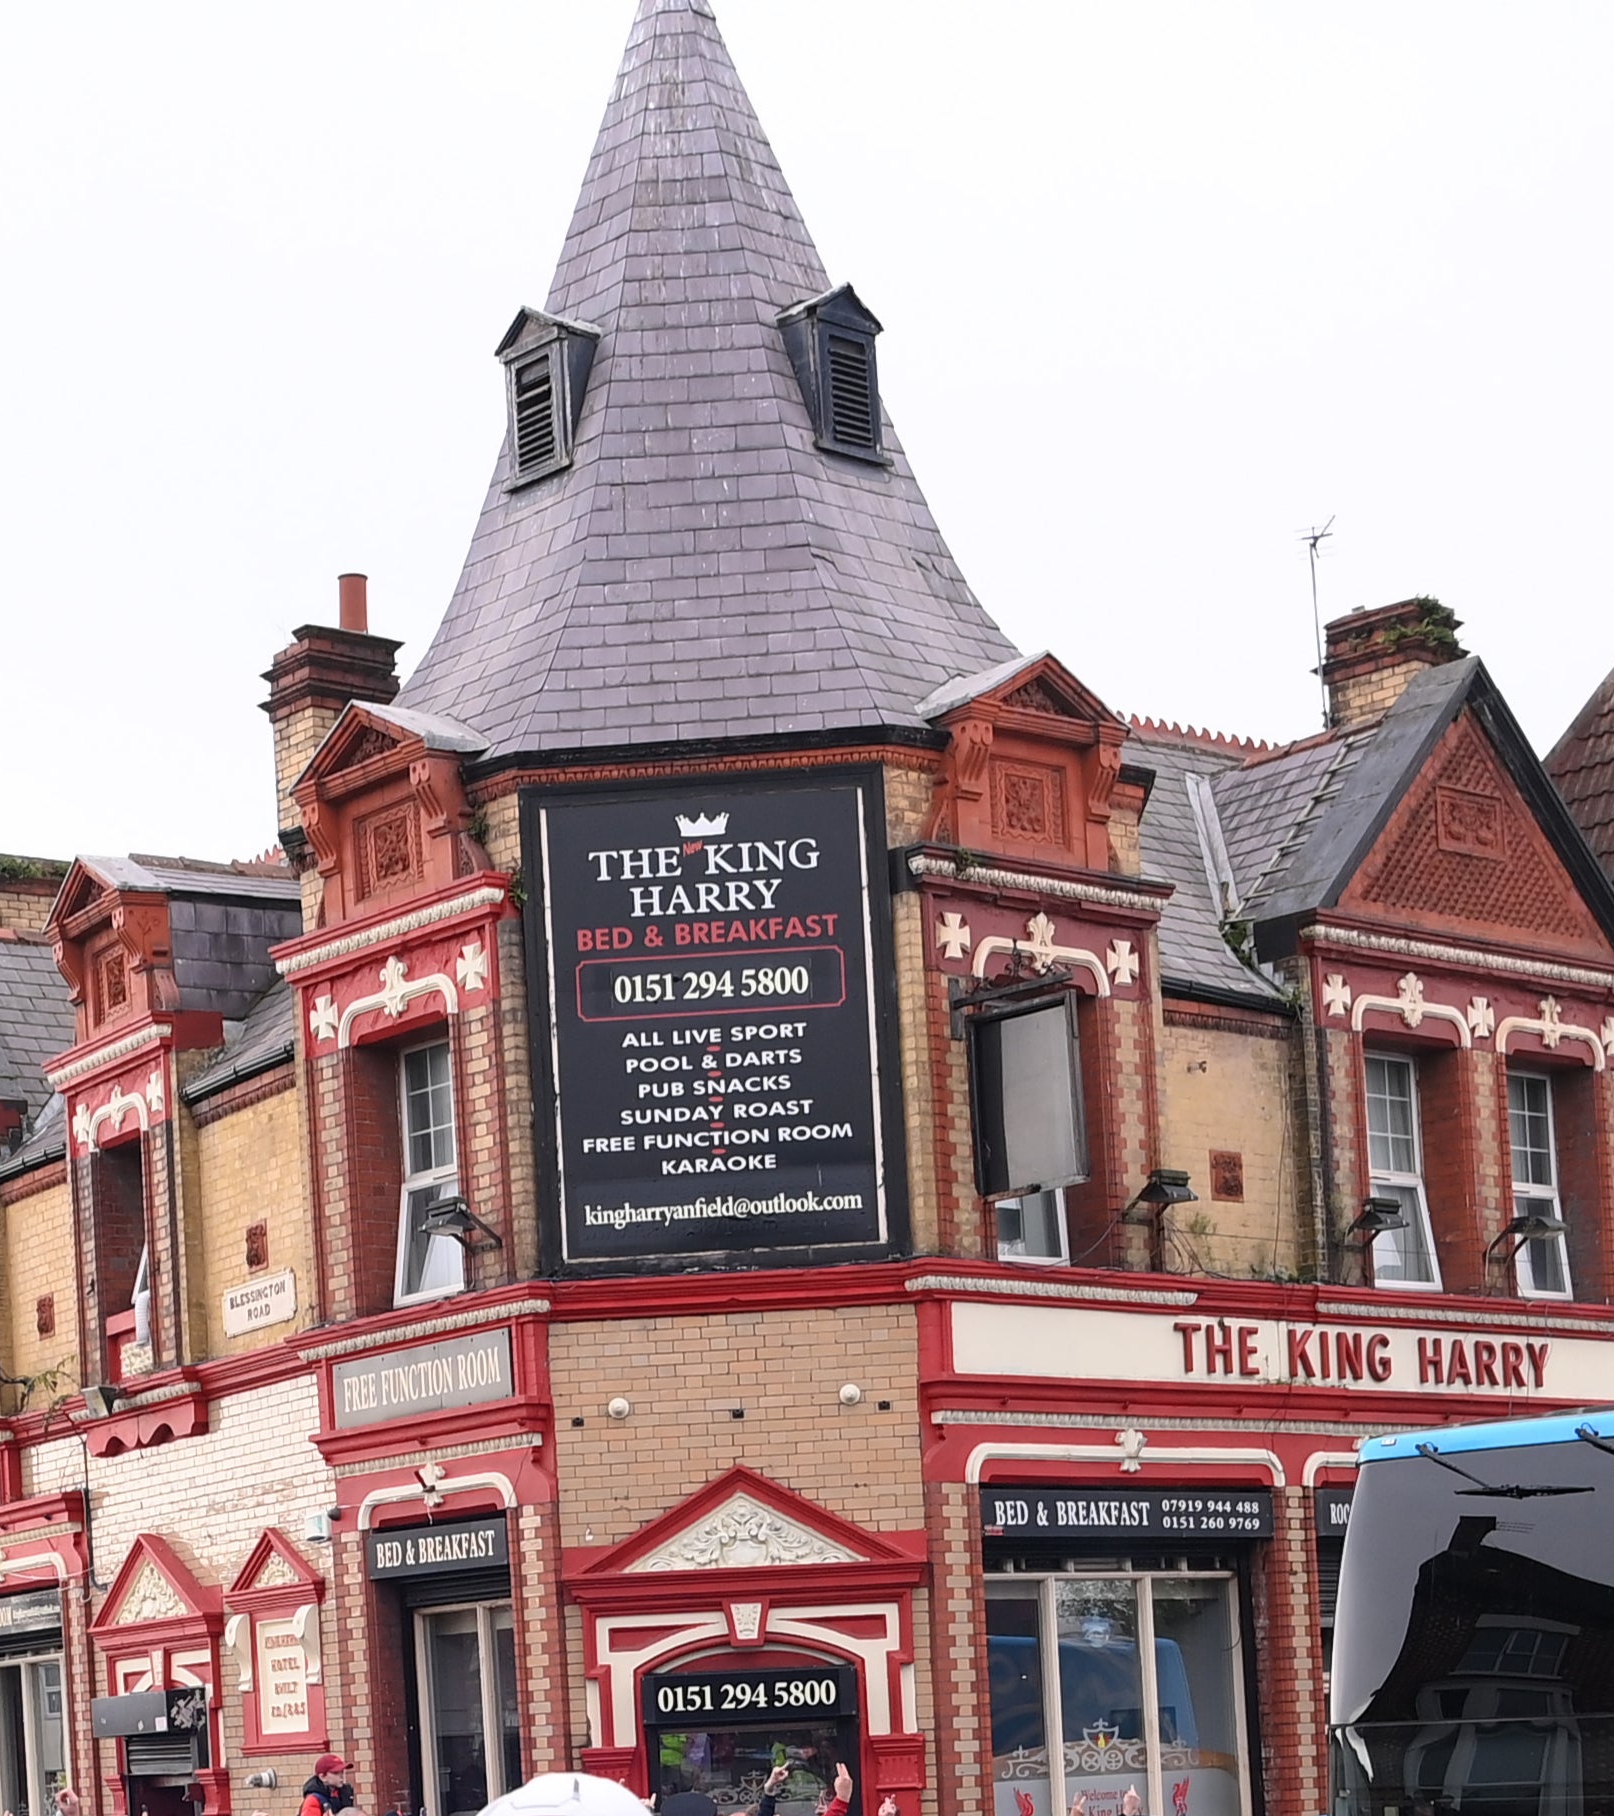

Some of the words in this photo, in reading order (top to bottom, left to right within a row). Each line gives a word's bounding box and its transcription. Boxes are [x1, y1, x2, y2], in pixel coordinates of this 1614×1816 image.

[588, 846, 681, 881] THE
[703, 838, 820, 875] KING
[683, 840, 702, 857] New
[630, 879, 782, 917] HARRY
[577, 926, 633, 951] BED
[644, 925, 664, 946] &
[675, 914, 838, 945] BREAKFAST
[614, 973, 675, 1002] 0151
[682, 970, 735, 999] 294
[740, 966, 809, 997] 5800
[622, 1031, 664, 1048] ALL
[673, 1028, 722, 1045] LIVE
[730, 1022, 807, 1041] SPORT
[626, 1055, 693, 1073] POOL
[701, 1054, 717, 1069] &
[726, 1049, 802, 1067] DARTS
[638, 1081, 684, 1099] PUB
[693, 1075, 791, 1095] SNACKS
[620, 1104, 723, 1125] SUNDAY
[734, 1099, 813, 1119] ROAST
[583, 1136, 635, 1153] FREE
[643, 1128, 769, 1150] FUNCTION
[778, 1123, 853, 1142] ROOM
[661, 1154, 777, 1175] KARAOKE
[585, 1191, 862, 1229] kingharryanfield@outlook.com
[229, 1279, 286, 1310] BLESSINGTON
[247, 1304, 271, 1321] ROAD
[1174, 1322, 1260, 1375] THE
[1288, 1328, 1392, 1382] KING
[1417, 1336, 1548, 1388] HARRY
[343, 1376, 377, 1413] FREE
[381, 1356, 455, 1406] FUNCTION
[458, 1346, 501, 1388] ROOM
[995, 1500, 1029, 1527] BED
[1036, 1502, 1049, 1526] &
[1056, 1501, 1150, 1527] BREAKFAST
[1161, 1499, 1203, 1513] 07919
[1207, 1500, 1231, 1513] 944
[1236, 1501, 1260, 1514] 488
[1162, 1516, 1187, 1530] 0151
[1200, 1516, 1224, 1530] 260
[1228, 1517, 1260, 1531] 9769
[376, 1541, 402, 1569] BED
[406, 1539, 416, 1566] &
[418, 1530, 495, 1564] BREAKFAST
[271, 1657, 300, 1672] HOTEL
[657, 1684, 714, 1713] 0151
[720, 1683, 768, 1709] 294
[774, 1679, 836, 1707] 5800
[1081, 1788, 1118, 1801] Welcome
